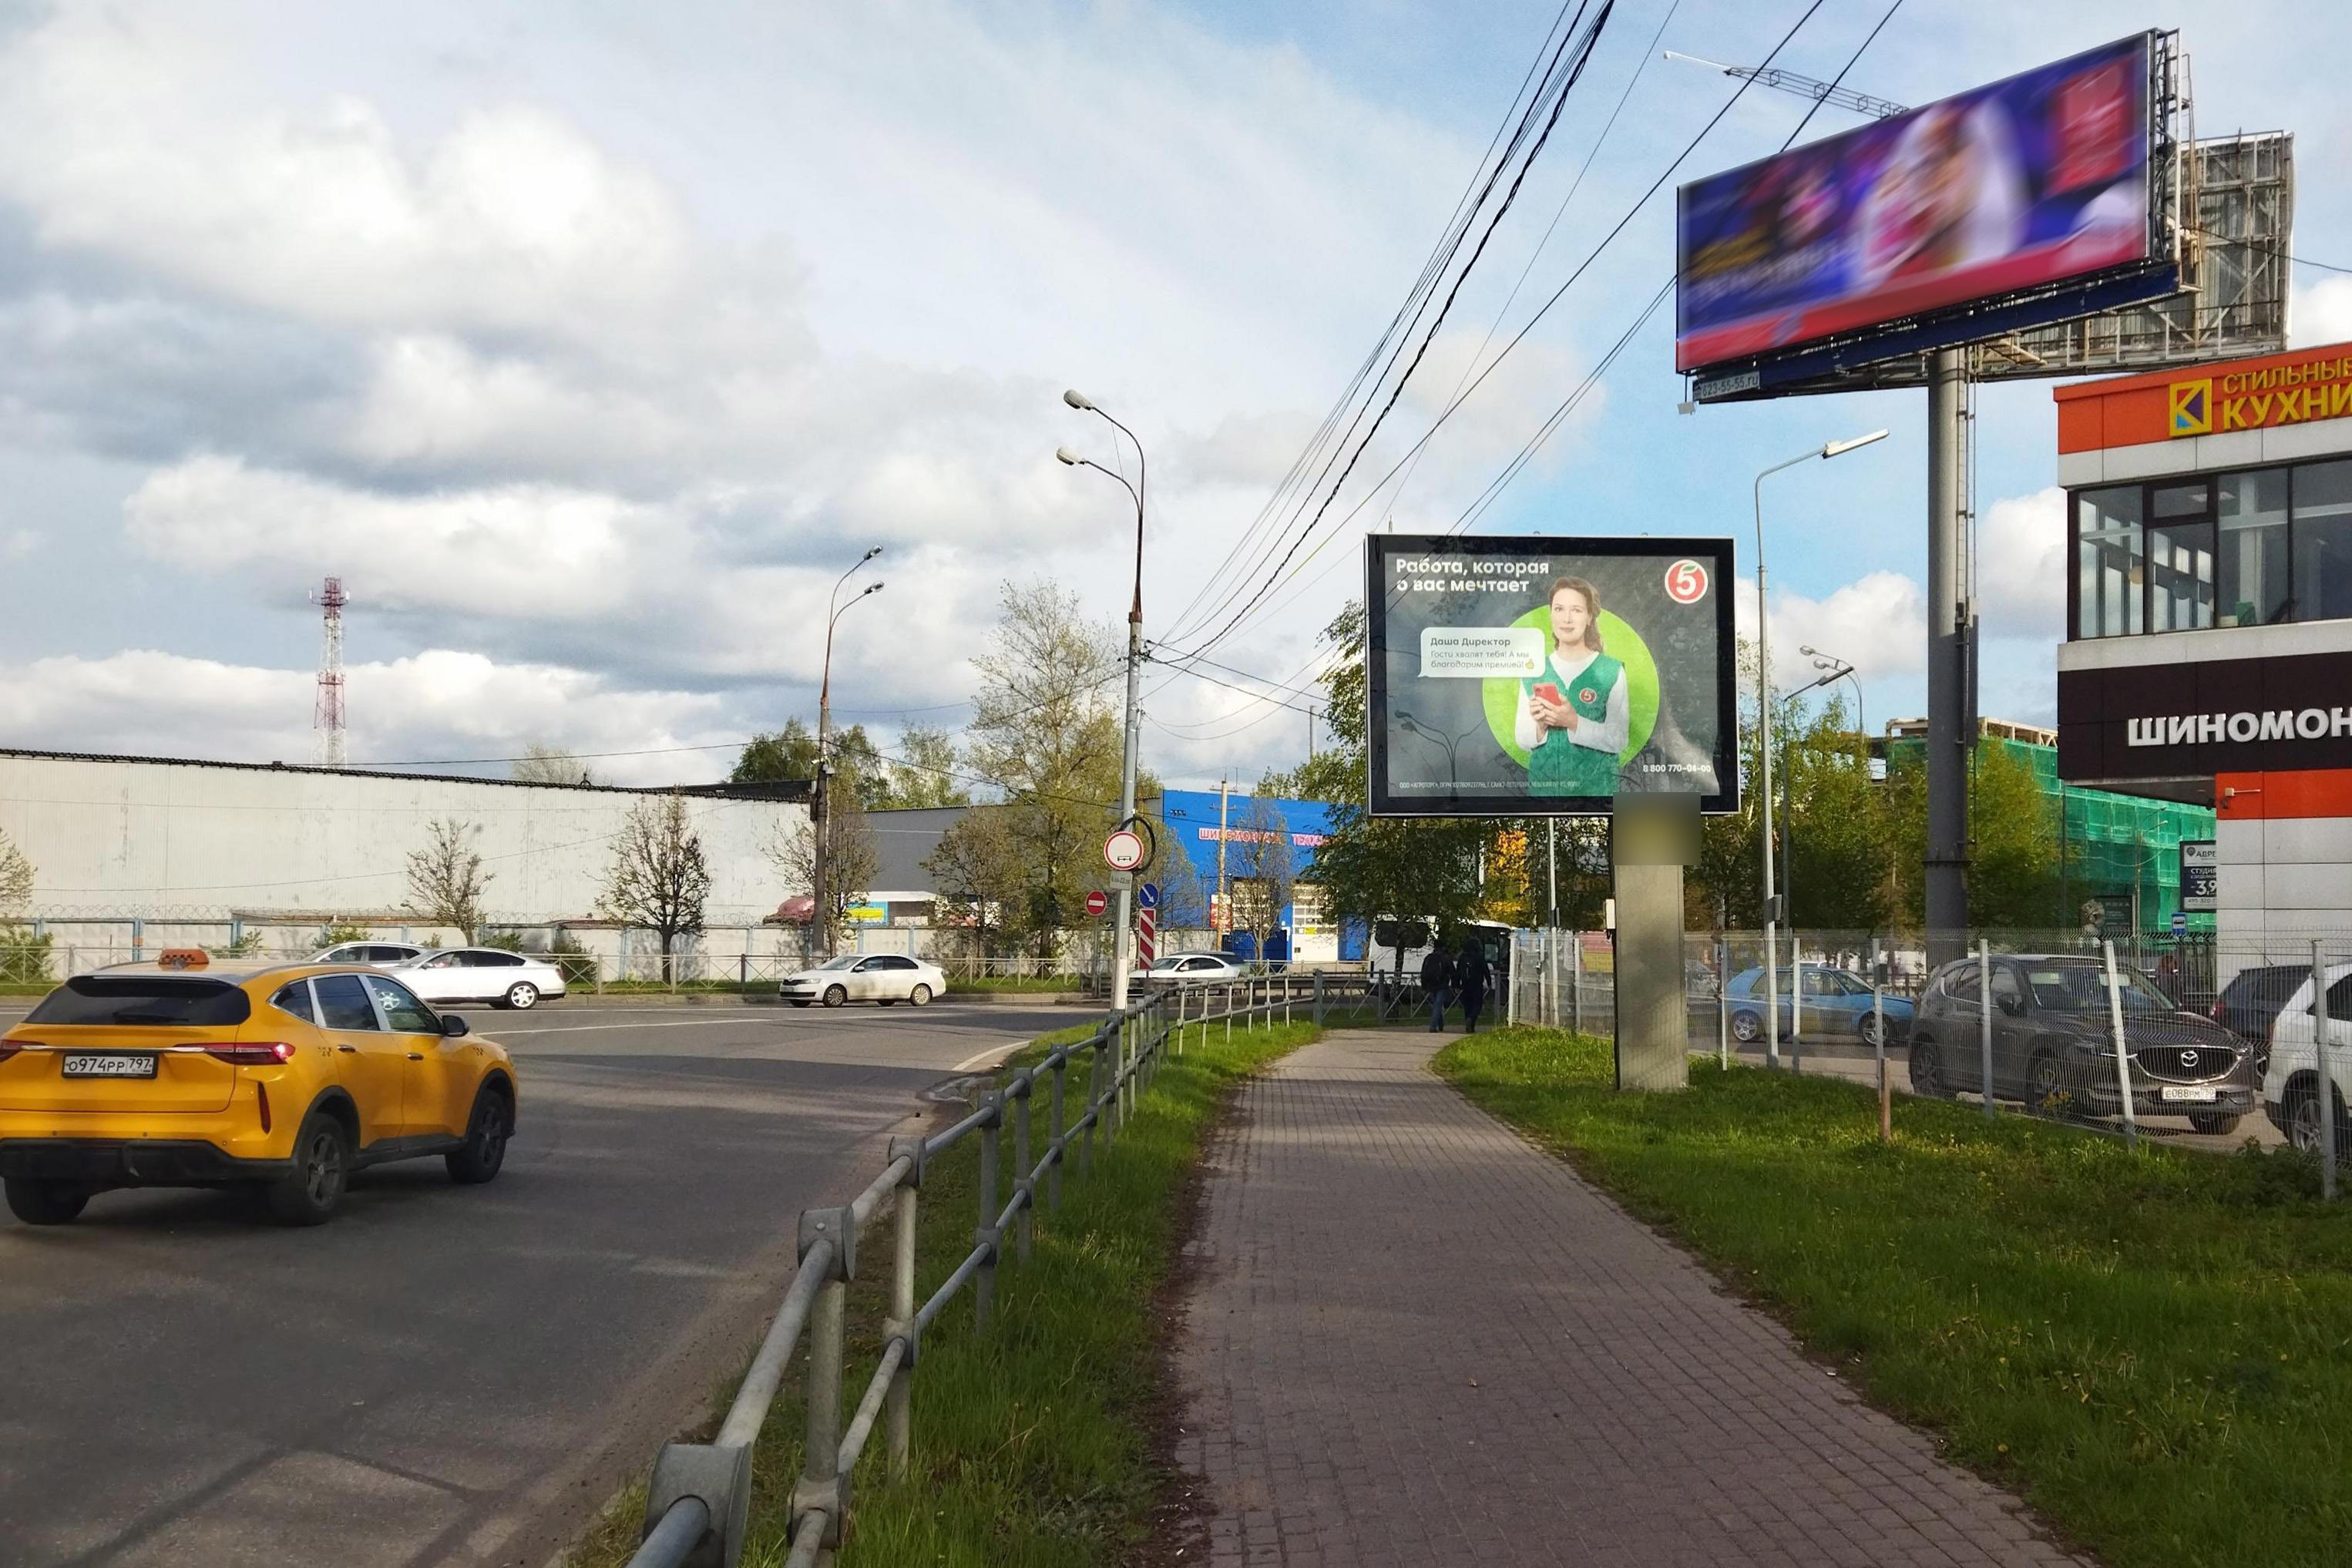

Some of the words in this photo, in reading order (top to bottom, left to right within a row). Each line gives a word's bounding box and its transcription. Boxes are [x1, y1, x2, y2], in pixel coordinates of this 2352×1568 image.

[2223, 358, 2352, 394] СТИЛЬНЫЕ
[2223, 381, 2352, 430] КУХНИ
[1396, 558, 1467, 576] Работа,
[1473, 562, 1549, 577] которая
[1397, 579, 1408, 591] о
[1413, 579, 1446, 592] вас
[1450, 579, 1530, 592] мечтает
[1430, 638, 1459, 646] Даша
[1462, 638, 1510, 647] Директор
[1431, 660, 1483, 670] благодарим
[1485, 661, 1524, 670] премией!
[2128, 707, 2352, 747] ШИНОМОН
[69, 1058, 125, 1072] О974РР
[129, 1058, 150, 1069] 797
